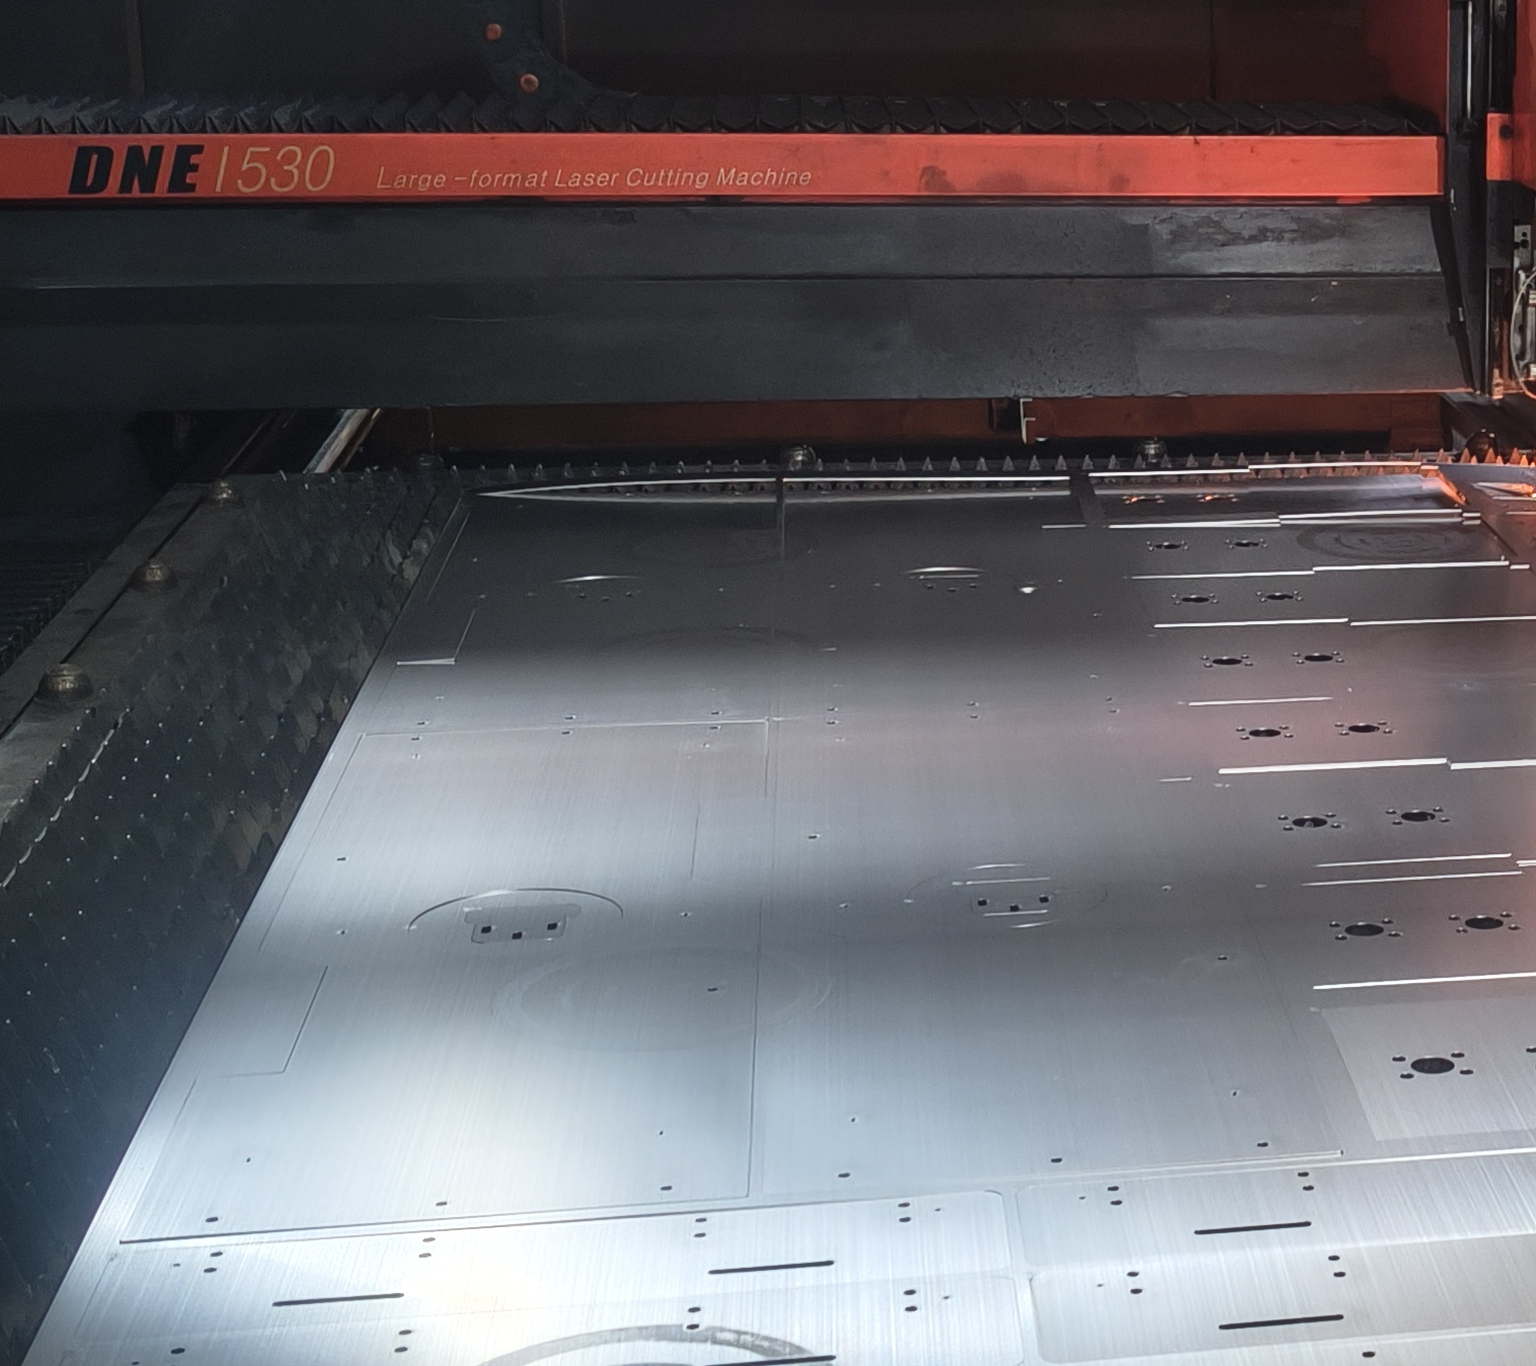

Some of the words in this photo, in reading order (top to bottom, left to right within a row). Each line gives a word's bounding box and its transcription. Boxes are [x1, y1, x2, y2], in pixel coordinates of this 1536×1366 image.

[67, 144, 205, 195] DNE
[215, 145, 335, 193] 1530
[554, 168, 619, 188] Laser
[626, 167, 709, 189] Cutting
[716, 167, 812, 186] Machine
